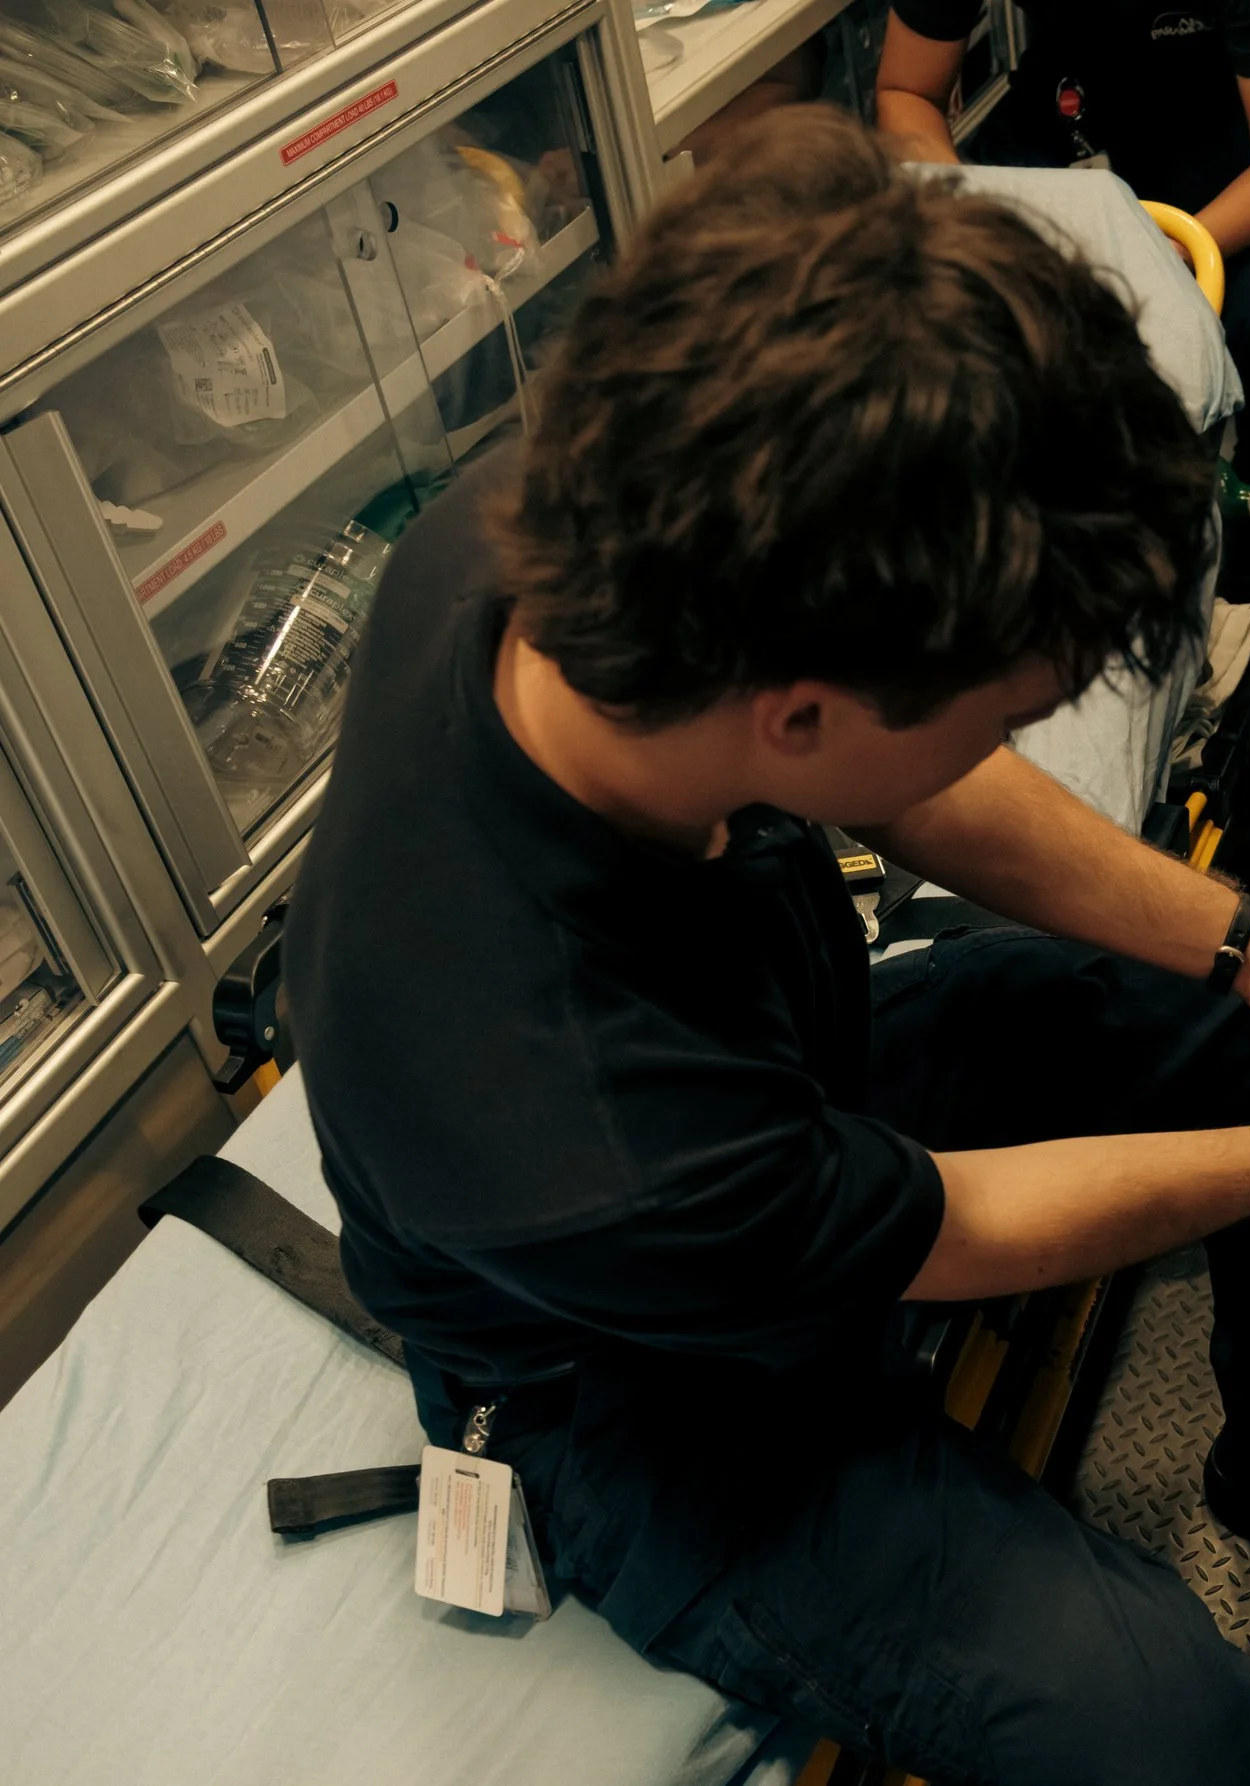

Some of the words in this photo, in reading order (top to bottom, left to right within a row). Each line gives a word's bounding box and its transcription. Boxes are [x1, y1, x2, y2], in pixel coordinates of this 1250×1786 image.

[309, 115, 346, 143] COMPARTMENT
[344, 108, 360, 121] LOAD
[163, 557, 185, 578] LOAD
[207, 522, 226, 541] LBS
